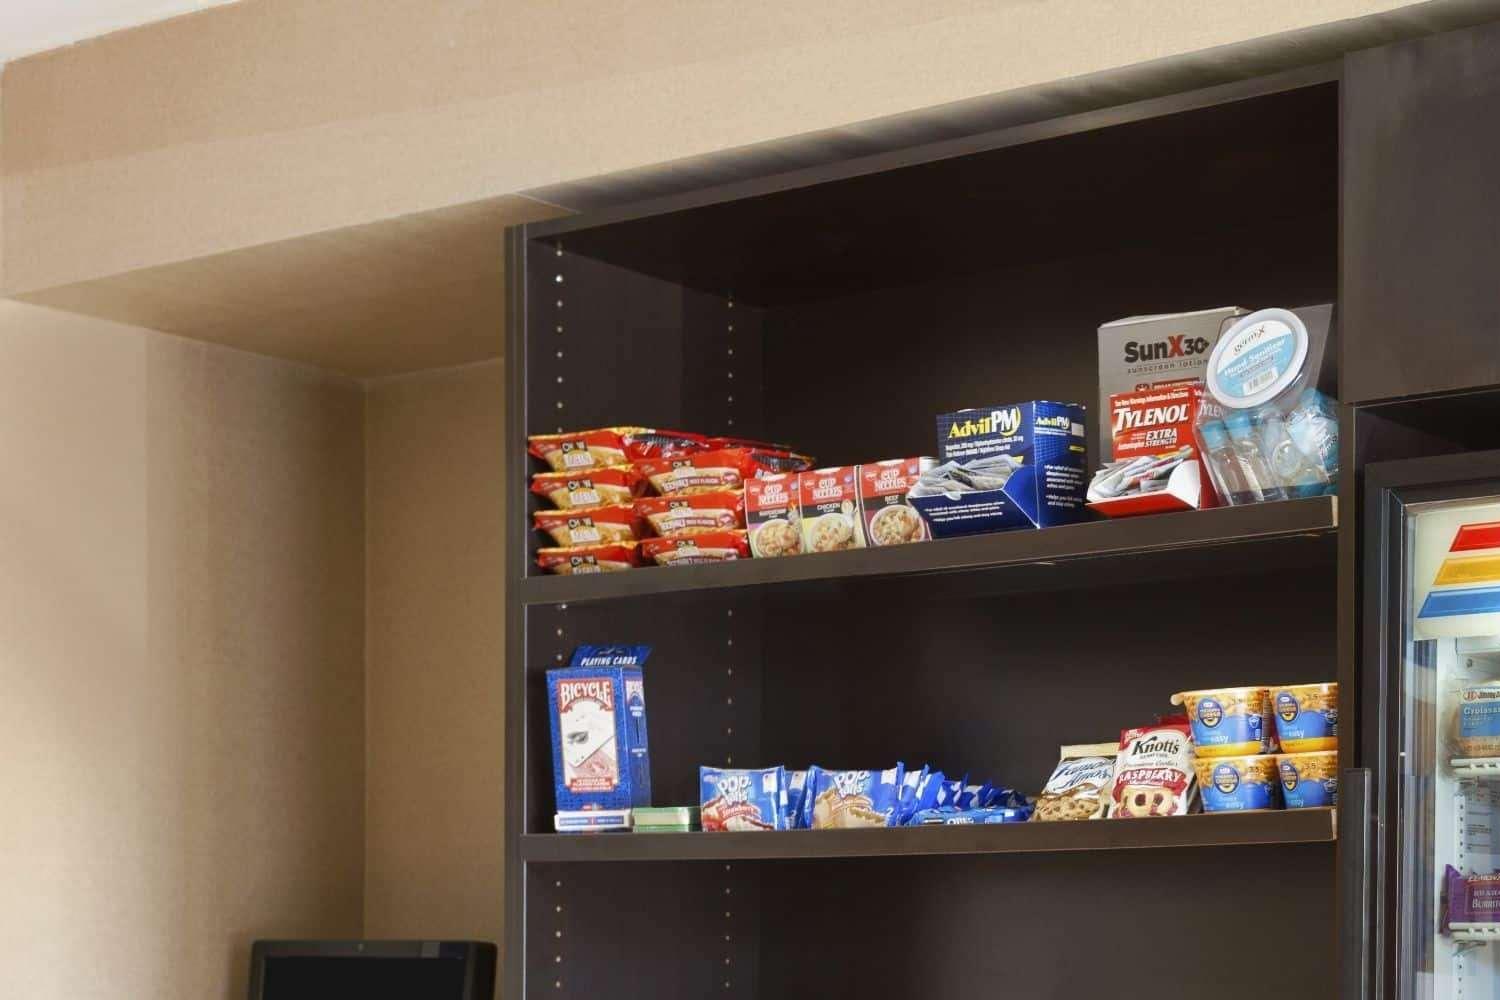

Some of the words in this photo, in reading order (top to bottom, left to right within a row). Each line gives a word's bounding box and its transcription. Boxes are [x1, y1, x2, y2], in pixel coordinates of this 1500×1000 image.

[1113, 403, 1190, 432] TYLENOL
[1145, 428, 1177, 440] EXTRA
[880, 468, 899, 480] CUP
[818, 478, 836, 488] CUP
[874, 478, 907, 492] NOODLES
[560, 680, 612, 712] BICYCLE
[1131, 736, 1180, 756] Knott's
[1118, 768, 1182, 784] RASPBERRY
